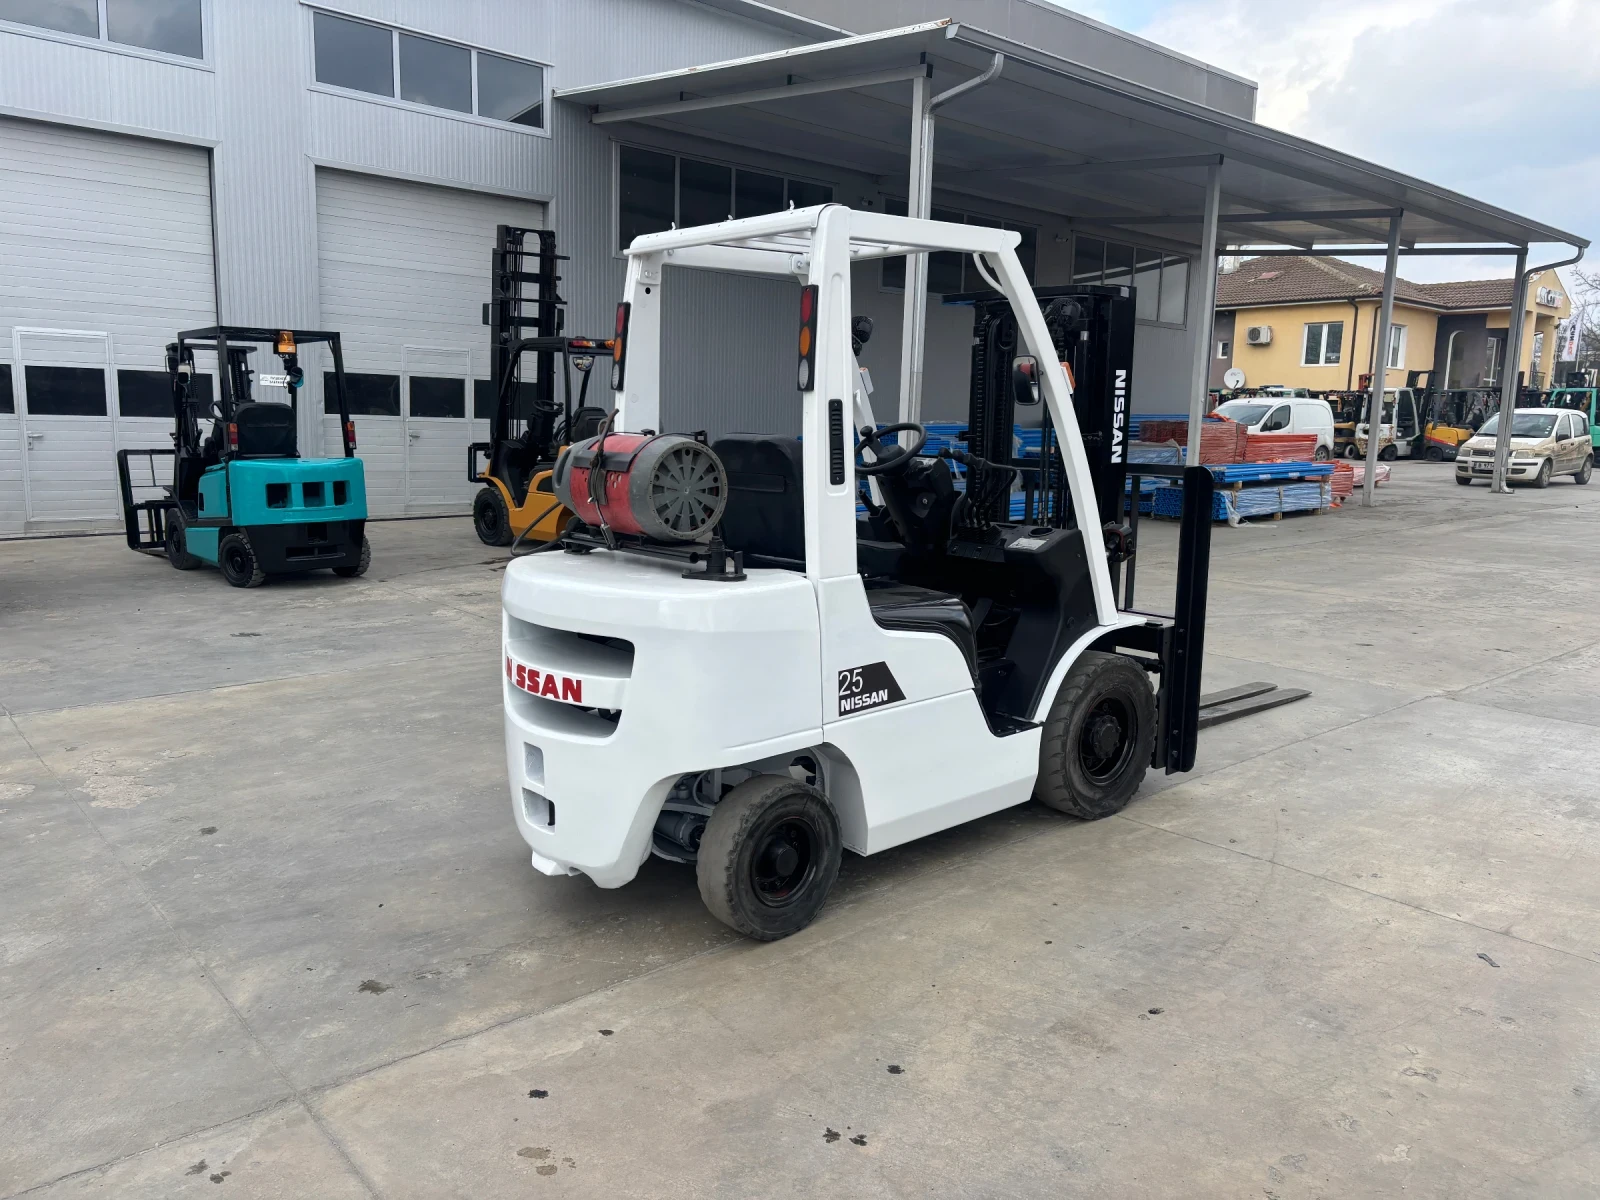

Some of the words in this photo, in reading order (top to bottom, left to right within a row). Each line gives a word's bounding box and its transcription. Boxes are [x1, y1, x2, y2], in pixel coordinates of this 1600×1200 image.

[1111, 369, 1127, 464] NISSAN
[506, 655, 582, 703] NSSAN
[839, 668, 863, 696] 25
[840, 688, 888, 713] NISSAN
